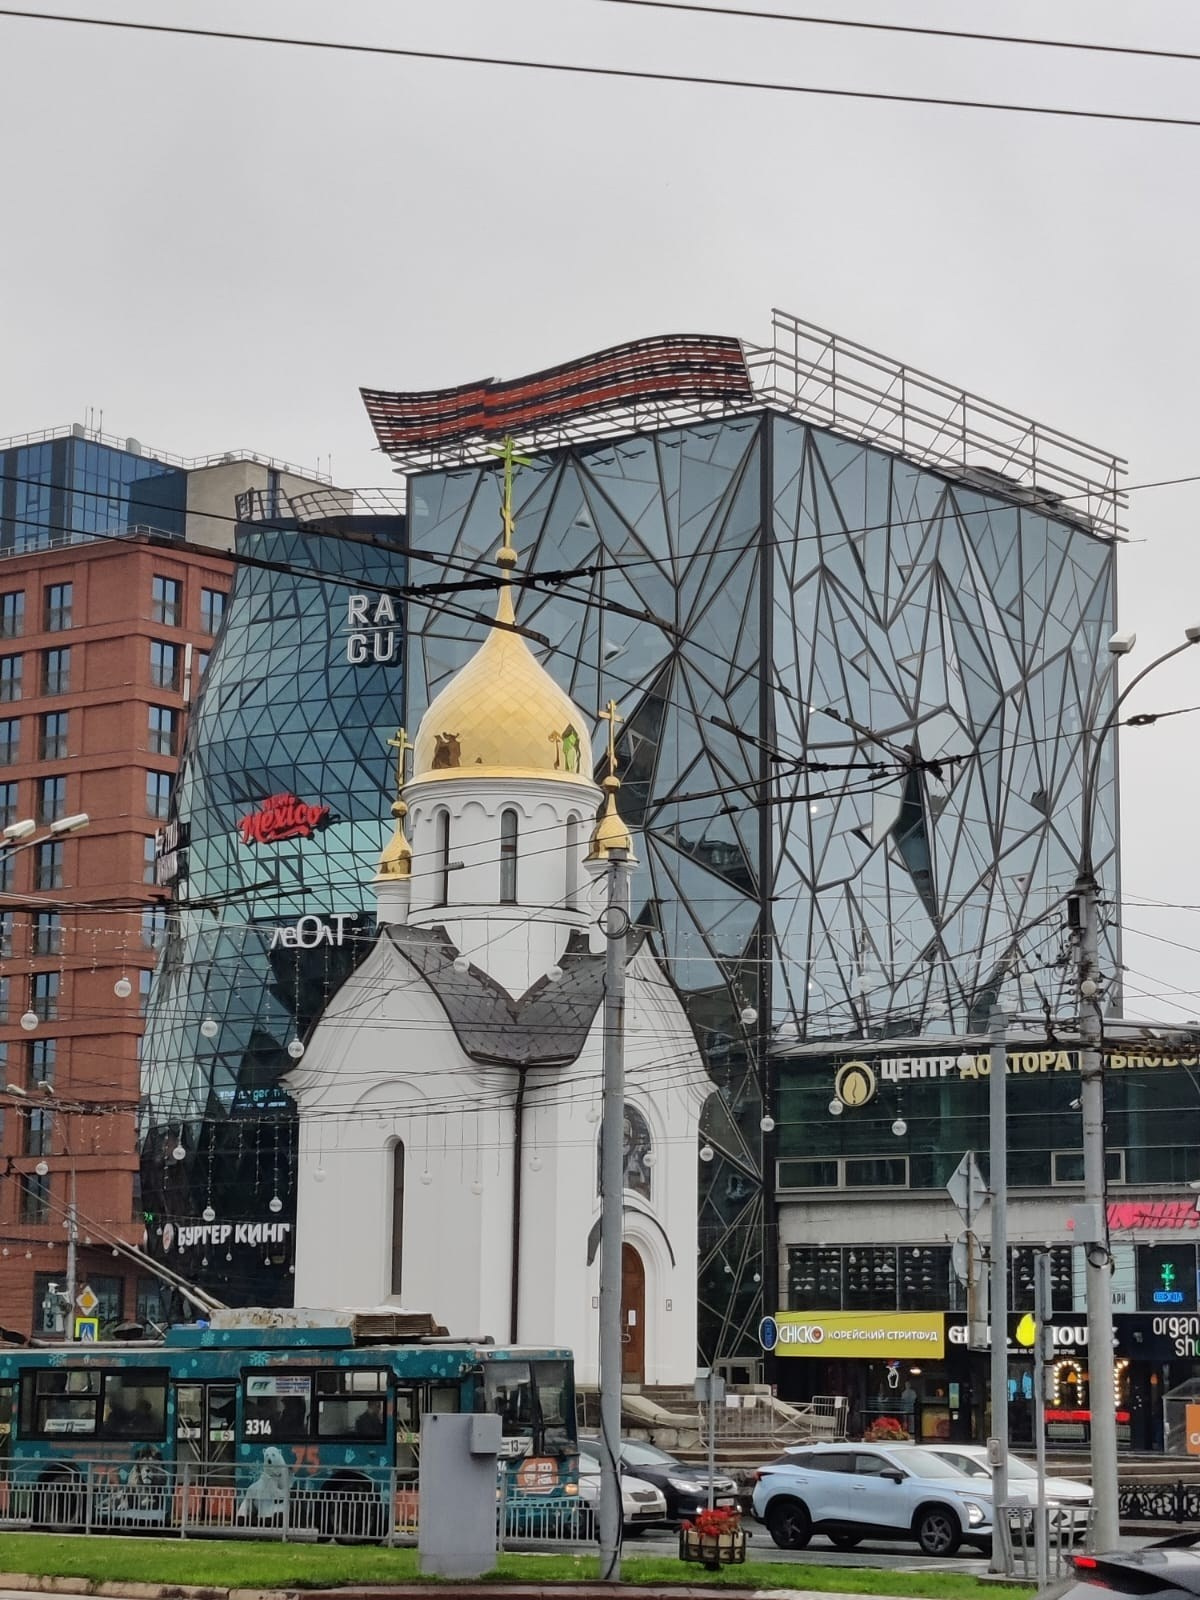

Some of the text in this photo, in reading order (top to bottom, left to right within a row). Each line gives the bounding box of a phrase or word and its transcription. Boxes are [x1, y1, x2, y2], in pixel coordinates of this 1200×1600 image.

[348, 594, 395, 624] RA
[347, 632, 394, 663] GU
[237, 804, 330, 844] Mexico
[881, 1057, 955, 1083] ЦЕНТР
[957, 1051, 1072, 1080] ДОТОРА
[178, 1223, 290, 1246] БУРГЕР КИНГ
[779, 1326, 824, 1344] CHICKO
[828, 1329, 885, 1341] КОРЕЙСКИЙ
[887, 1330, 938, 1342] СТРИТФУД
[245, 1419, 272, 1435] 3314
[511, 1440, 519, 1452] 13
